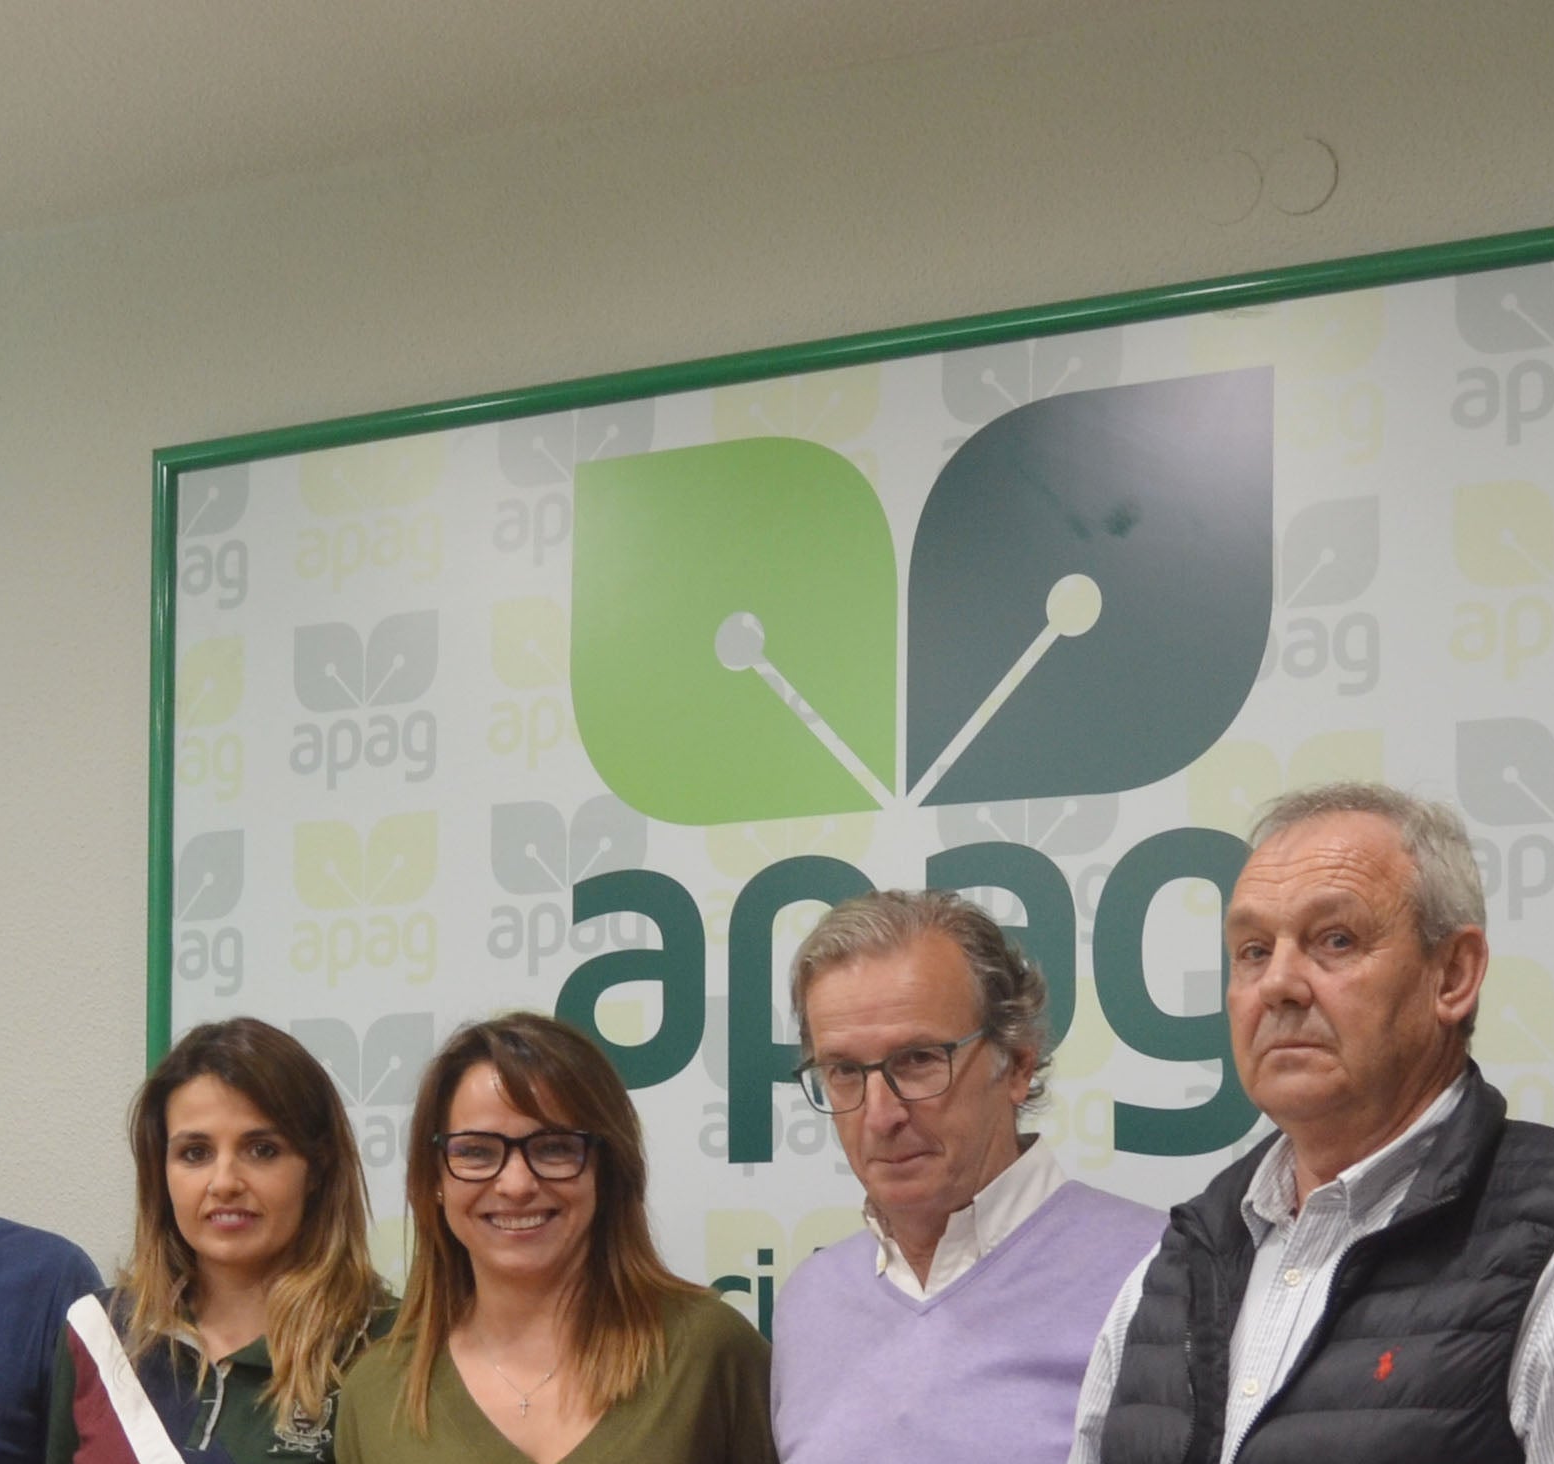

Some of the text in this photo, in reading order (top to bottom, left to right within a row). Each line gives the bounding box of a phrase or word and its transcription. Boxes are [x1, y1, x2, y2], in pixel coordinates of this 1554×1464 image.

[294, 511, 444, 594] apag
[1258, 612, 1380, 697] ag
[289, 709, 437, 791] apag
[289, 910, 437, 989] apag
